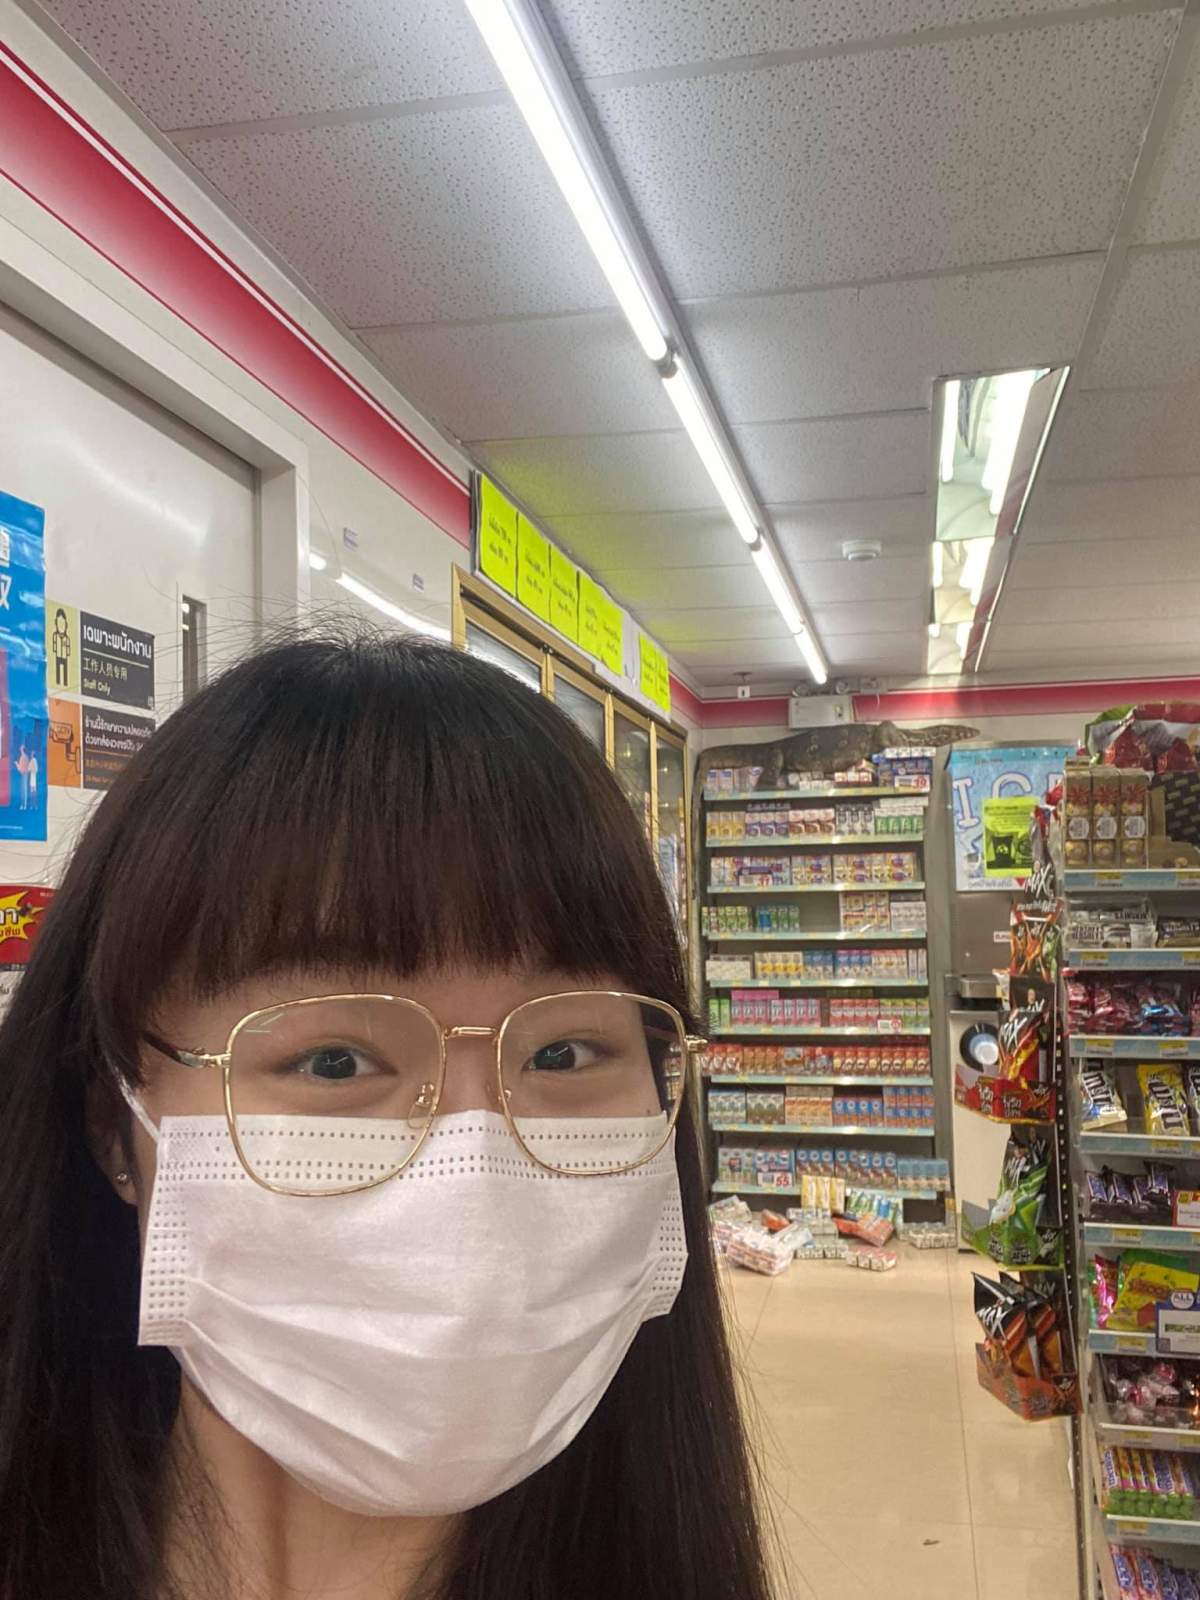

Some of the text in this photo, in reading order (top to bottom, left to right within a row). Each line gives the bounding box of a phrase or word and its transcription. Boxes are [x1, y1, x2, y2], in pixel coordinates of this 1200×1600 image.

[83, 624, 152, 659] เฉพาะพนักงาน
[83, 657, 128, 681] 工作人员专用
[83, 678, 111, 697] Staff Only
